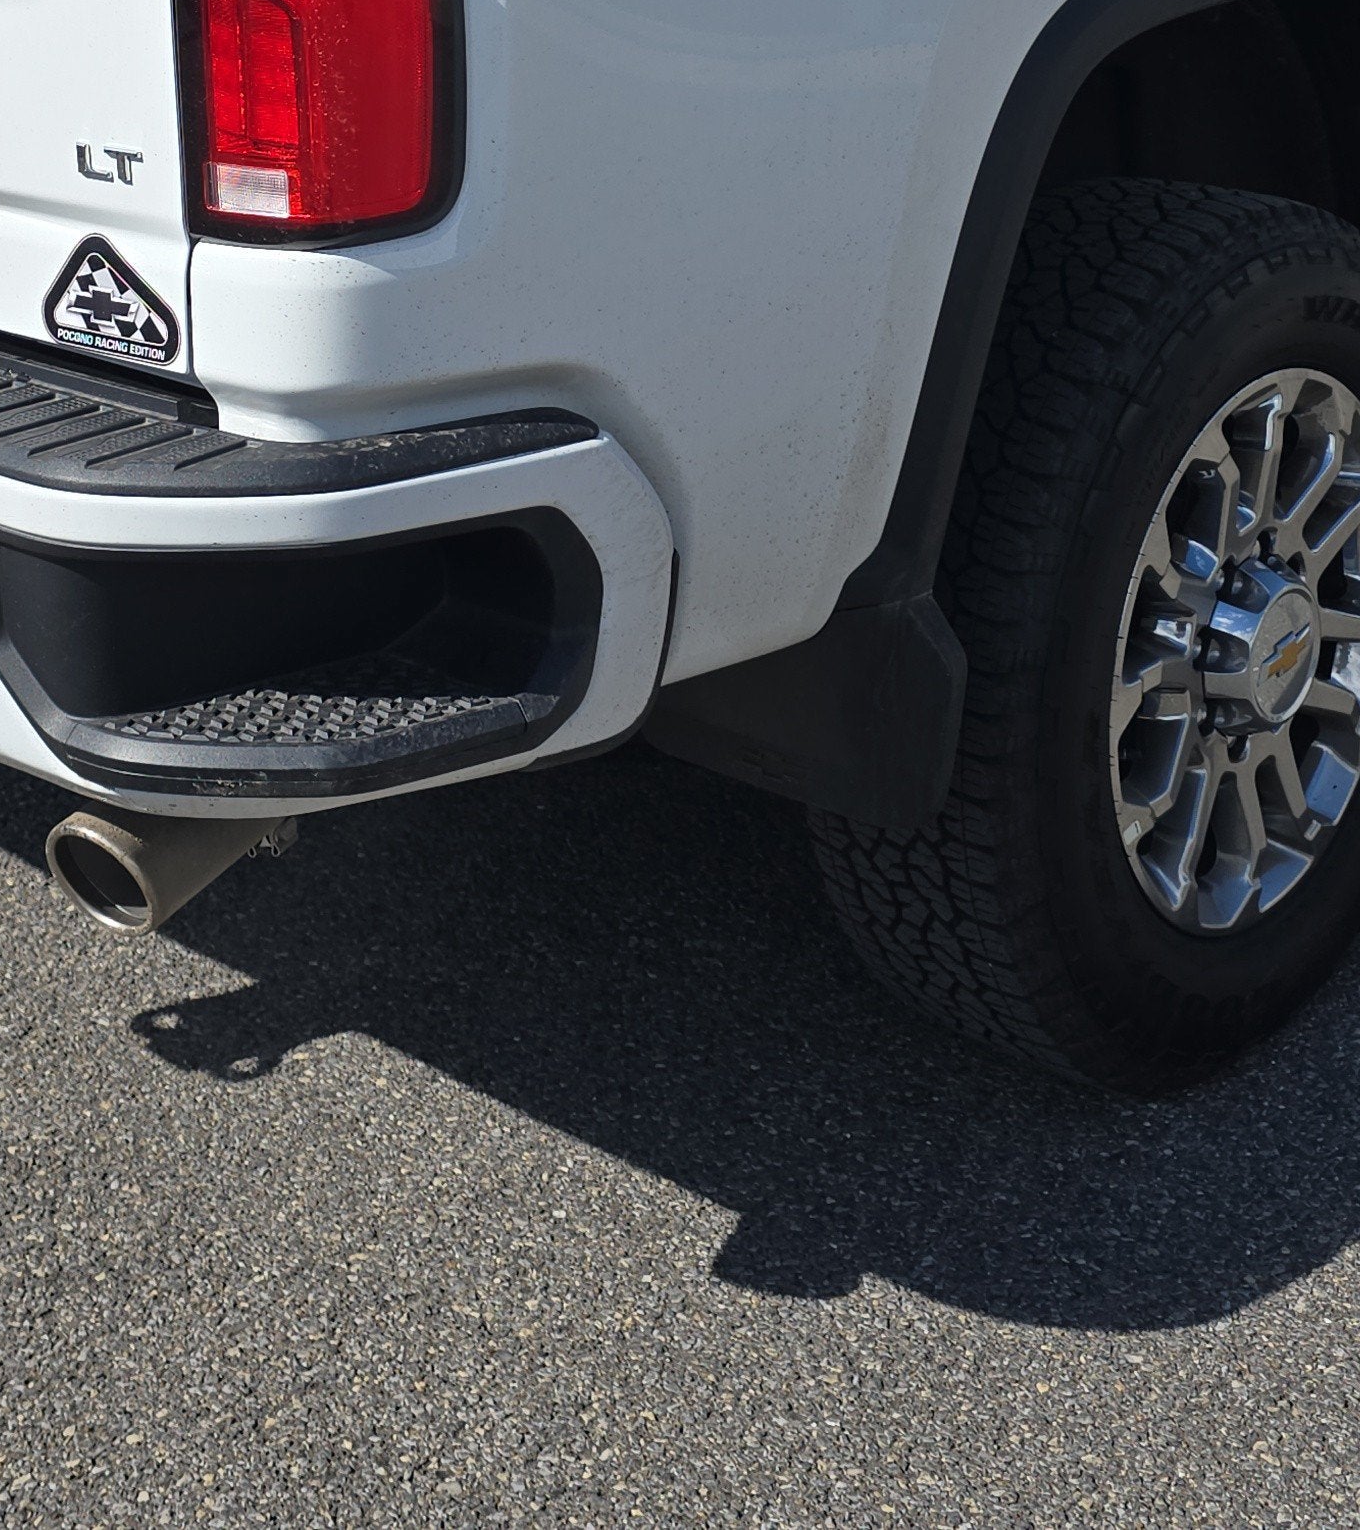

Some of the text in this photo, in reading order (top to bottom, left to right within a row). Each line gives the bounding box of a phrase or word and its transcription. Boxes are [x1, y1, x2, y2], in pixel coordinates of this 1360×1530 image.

[76, 142, 144, 186] LT
[57, 328, 166, 361] POCONO RACING EDITION
